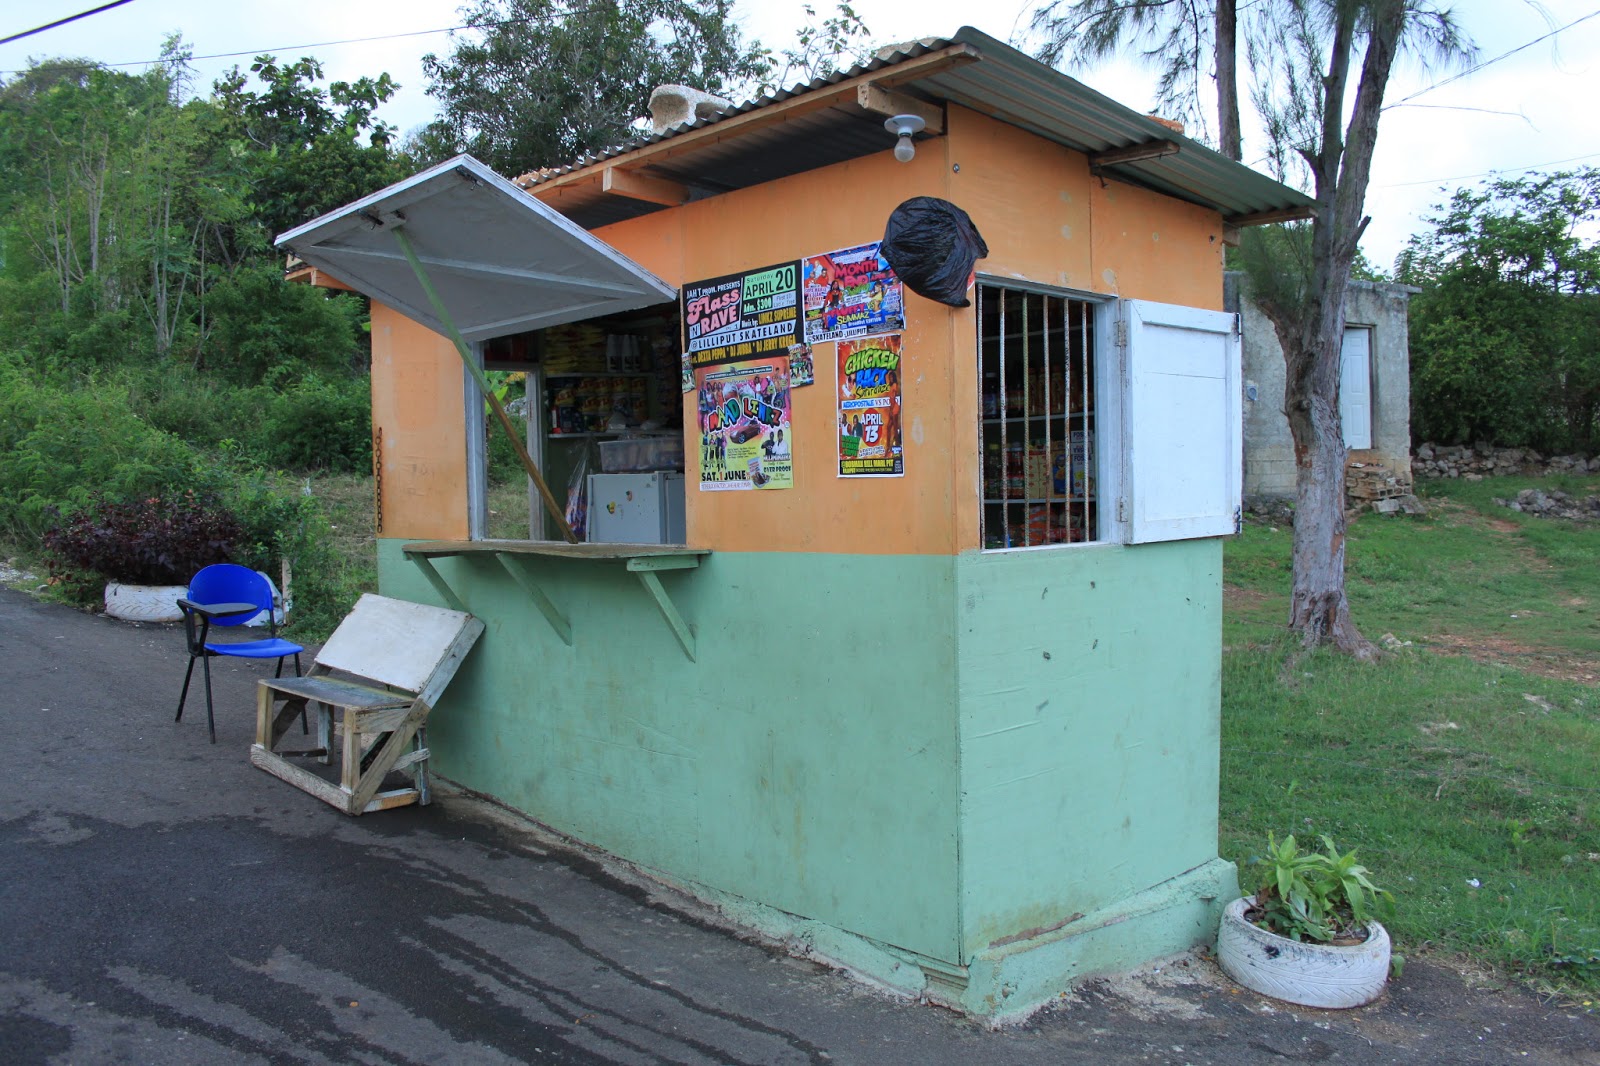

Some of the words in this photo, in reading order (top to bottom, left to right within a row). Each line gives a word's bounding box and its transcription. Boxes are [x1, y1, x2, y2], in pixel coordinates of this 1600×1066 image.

[835, 259, 878, 279] MONTH
[718, 280, 740, 292] PRESENTS
[745, 280, 774, 298] APRIL
[776, 267, 794, 291] 20
[746, 274, 774, 284] Saturday
[757, 297, 772, 311] $300
[700, 306, 736, 334] RAVE
[740, 322, 793, 341] SKATELAND
[844, 348, 900, 376] CHICKEN
[856, 368, 888, 389] BACK
[843, 400, 874, 408] AEROPOSTALE
[708, 399, 740, 432] MAAD
[742, 397, 782, 428] LINKZ
[860, 413, 884, 426] APRIL
[702, 472, 719, 482] SAT.
[720, 471, 724, 480] 1
[724, 470, 746, 480] JUNE
